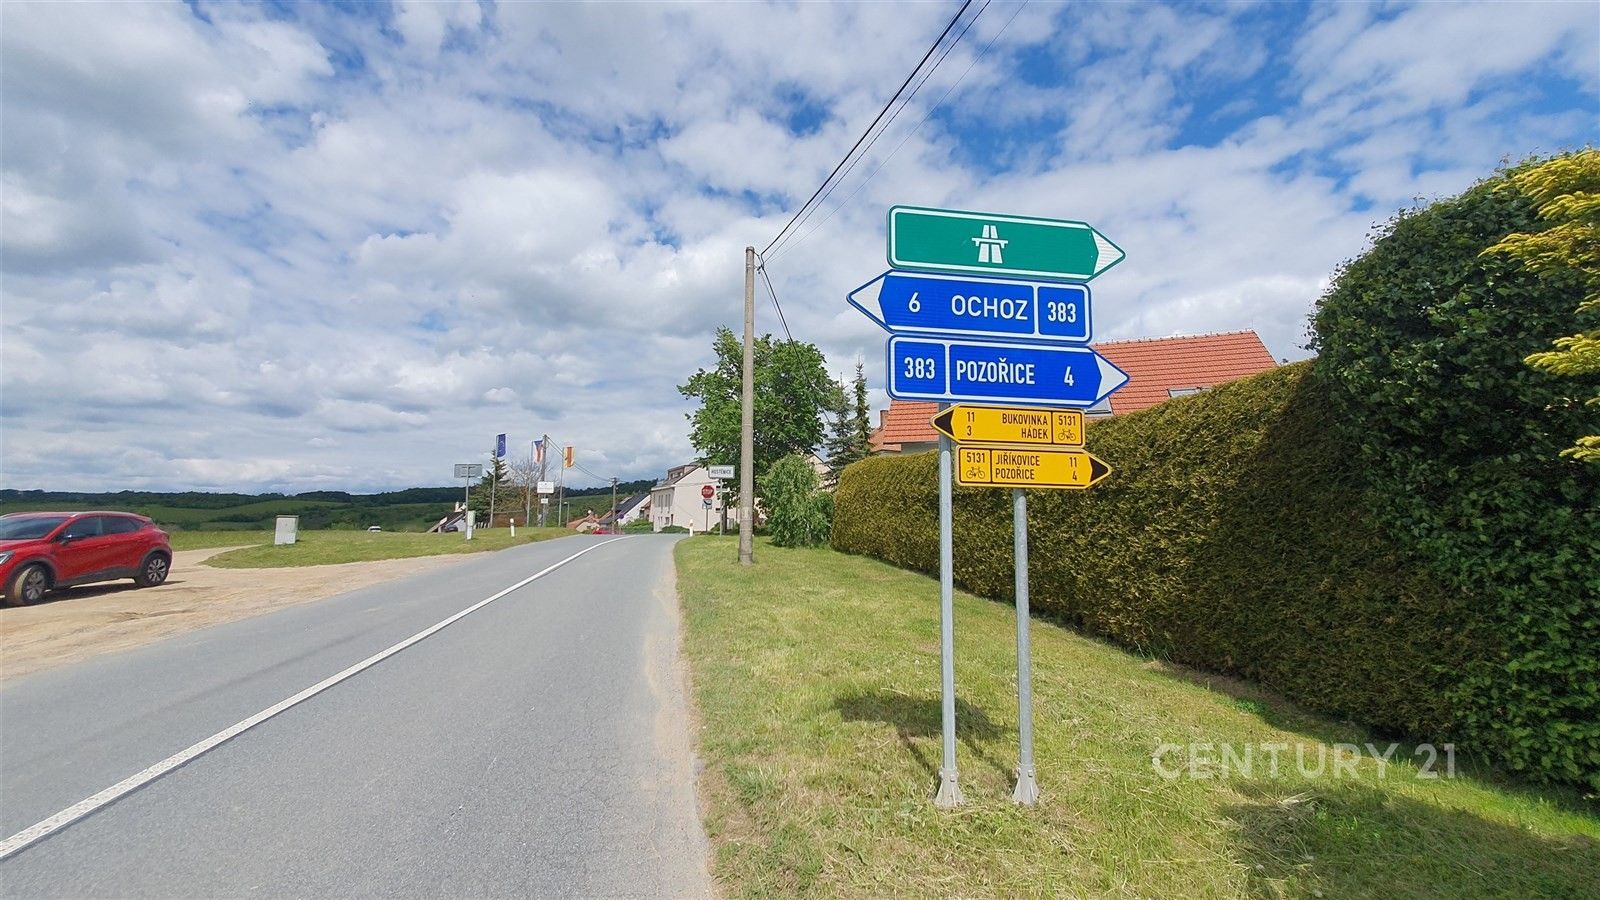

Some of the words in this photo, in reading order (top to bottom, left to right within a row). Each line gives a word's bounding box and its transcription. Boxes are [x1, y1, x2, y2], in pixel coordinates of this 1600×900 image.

[908, 292, 921, 313] 6
[951, 295, 1028, 321] OCHOZ
[1047, 301, 1076, 323] 383
[904, 357, 935, 379] 383
[956, 357, 1035, 385] POZOŘICE
[1063, 366, 1075, 387] 4
[967, 411, 975, 422] 11
[1002, 413, 1048, 426] BUKOVINKA
[1058, 415, 1076, 426] 5131
[966, 425, 972, 436] 3
[1022, 426, 1048, 439] HÁDEK
[966, 452, 985, 463] 5131
[995, 452, 1040, 466] JIŘÍKOVICE
[1069, 457, 1077, 468] 11
[995, 466, 1035, 480] POZOŘICE
[1072, 470, 1077, 481] 4
